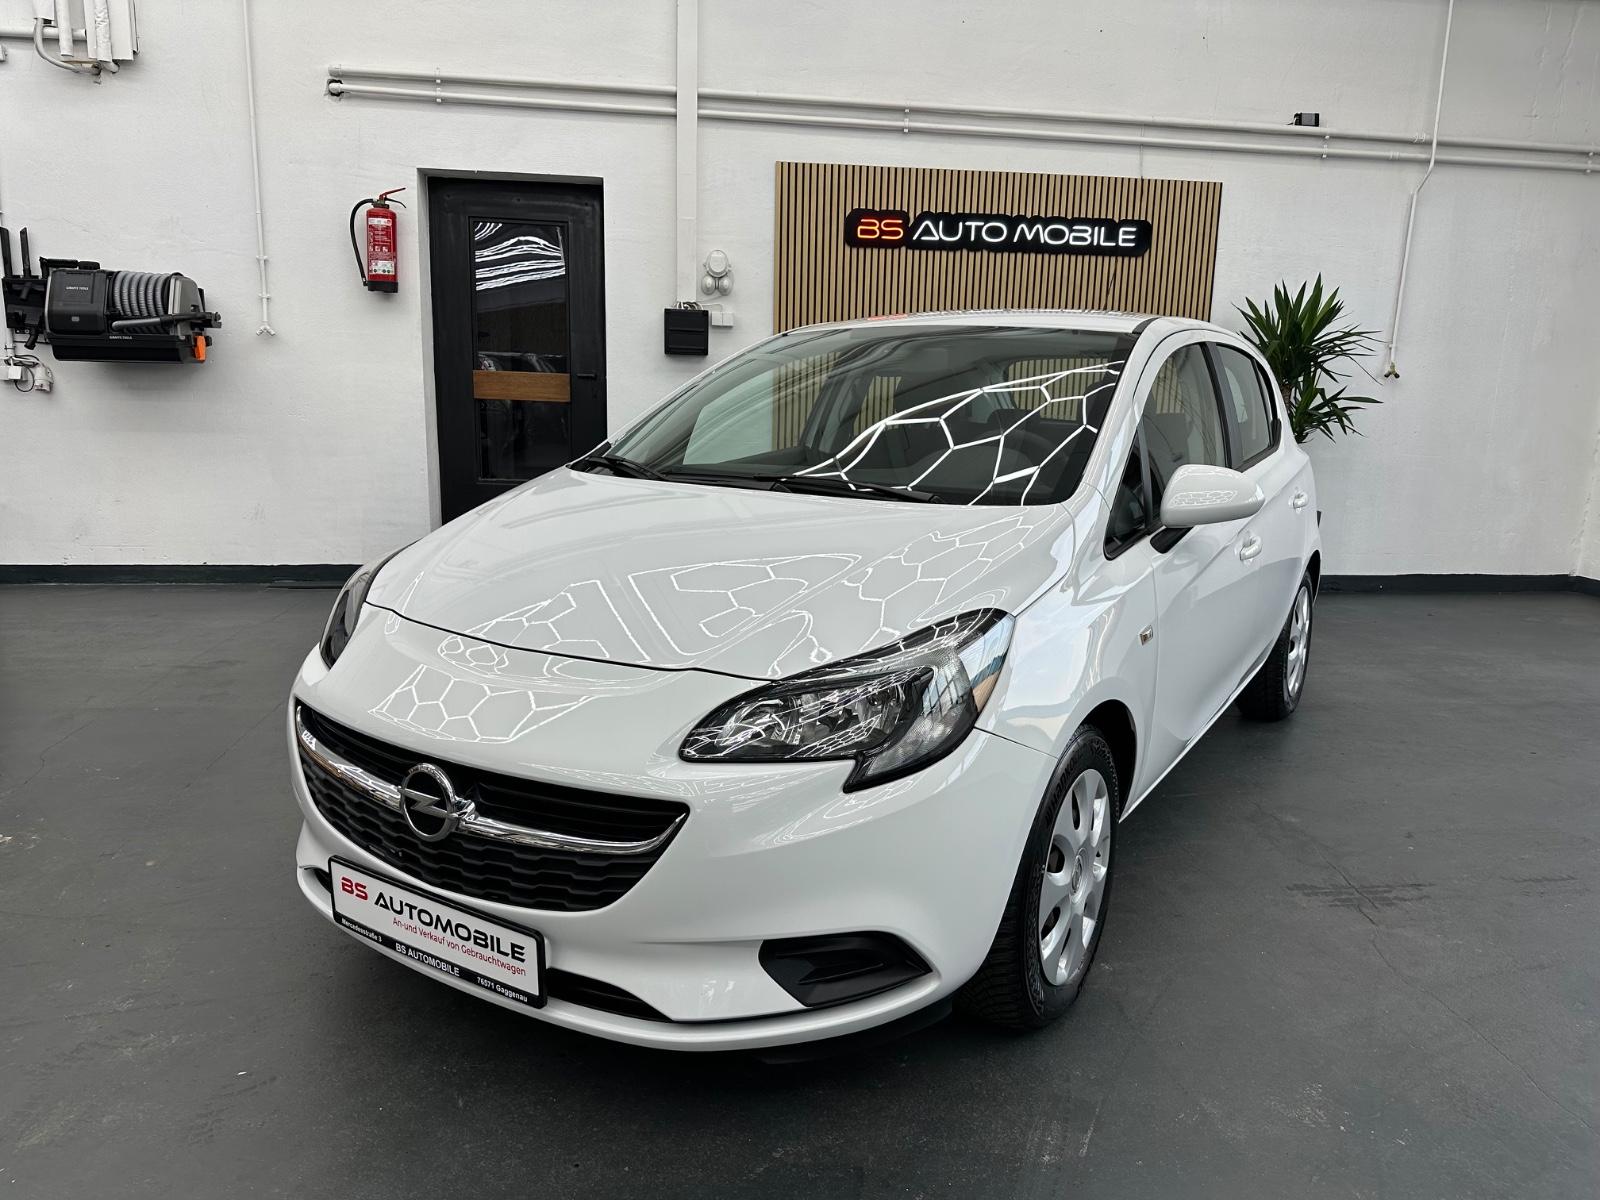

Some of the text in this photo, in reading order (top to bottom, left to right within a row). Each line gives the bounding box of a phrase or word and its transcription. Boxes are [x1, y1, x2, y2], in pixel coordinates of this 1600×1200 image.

[857, 218, 1137, 247] BS AUTO MOBILE
[341, 876, 526, 963] BS AUTOMOBILE
[395, 942, 460, 977] BS AUTOMOBILE
[419, 928, 445, 945] Verkauf
[447, 941, 460, 951] von
[461, 944, 527, 976] Gebrauchtwagen
[495, 984, 528, 1002] Gaggenau
